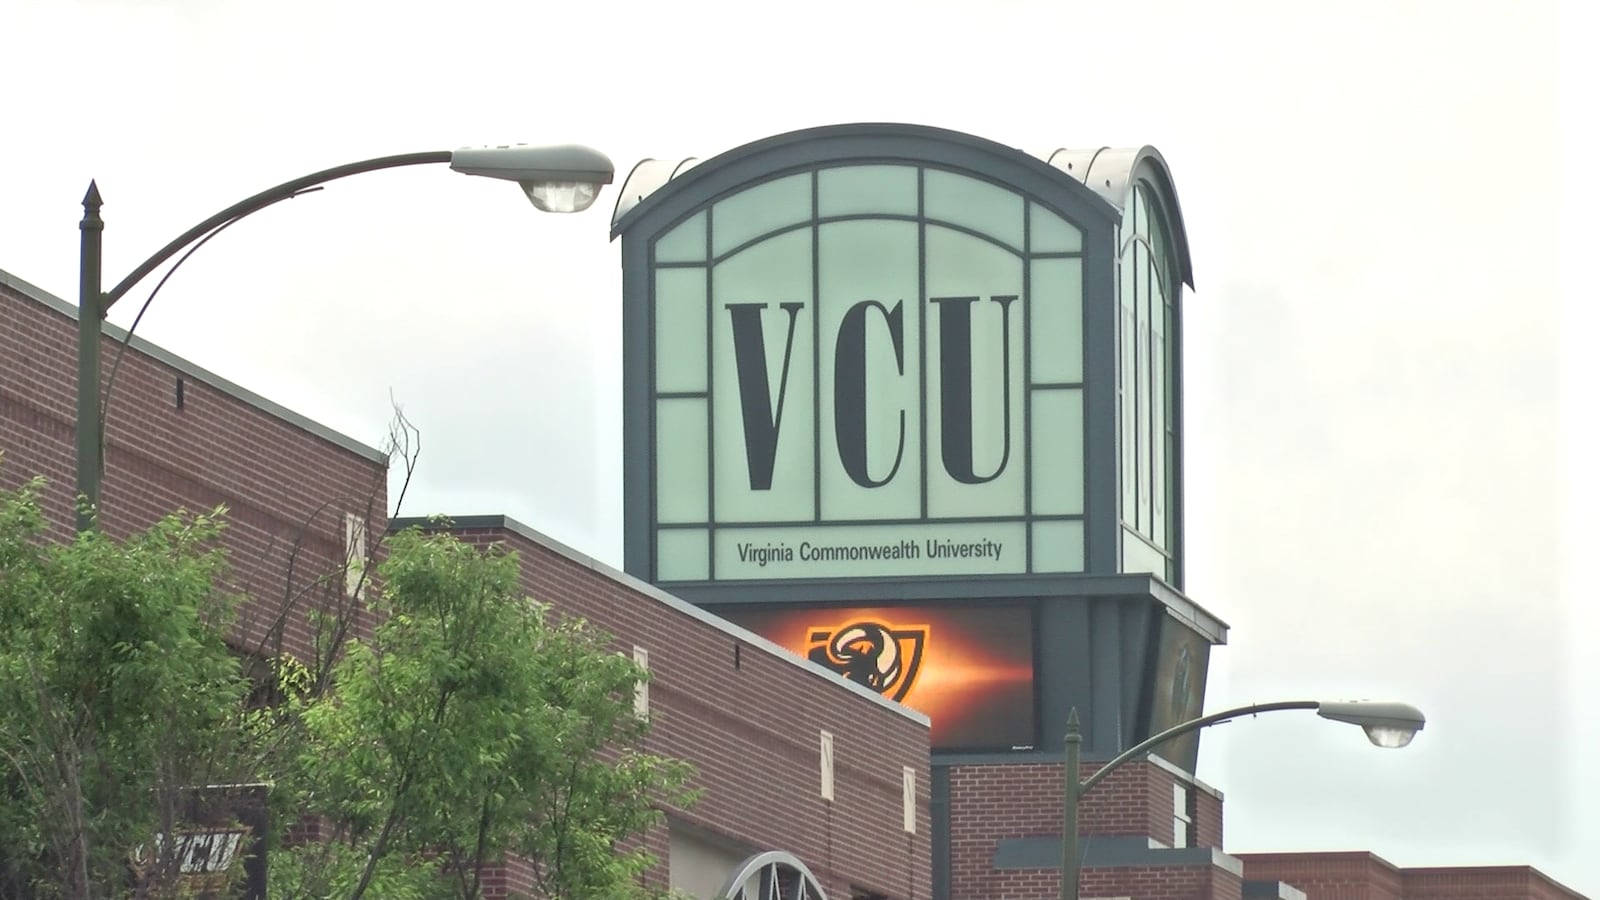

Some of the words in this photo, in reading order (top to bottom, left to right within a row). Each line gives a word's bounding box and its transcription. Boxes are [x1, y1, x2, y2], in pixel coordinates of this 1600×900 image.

[724, 295, 1019, 490] VCU
[737, 542, 794, 567] Virginia
[799, 538, 920, 561] Commonwealth
[926, 537, 1003, 561] University
